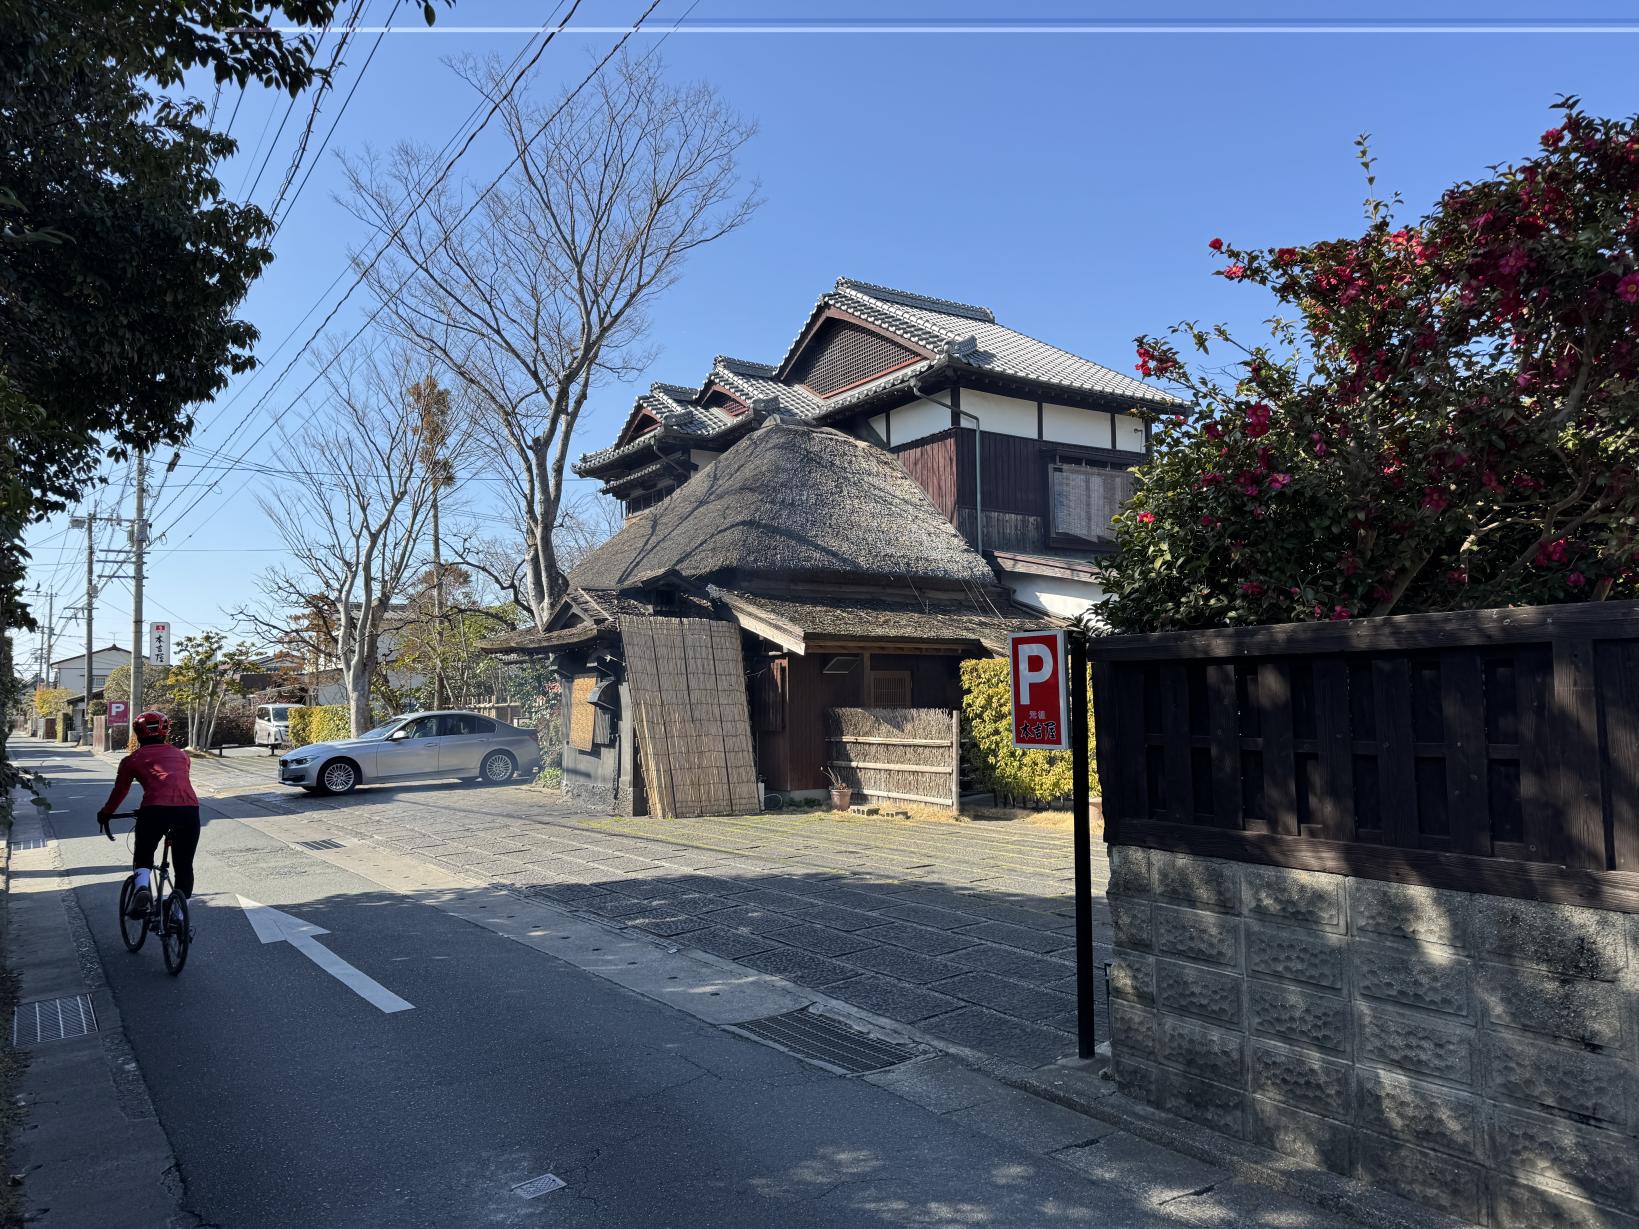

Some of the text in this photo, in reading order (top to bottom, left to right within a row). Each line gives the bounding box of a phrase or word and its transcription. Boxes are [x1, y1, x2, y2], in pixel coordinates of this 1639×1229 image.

[1018, 643, 1054, 705] P
[111, 703, 125, 716] P
[1020, 720, 1057, 740] 本吉屋
